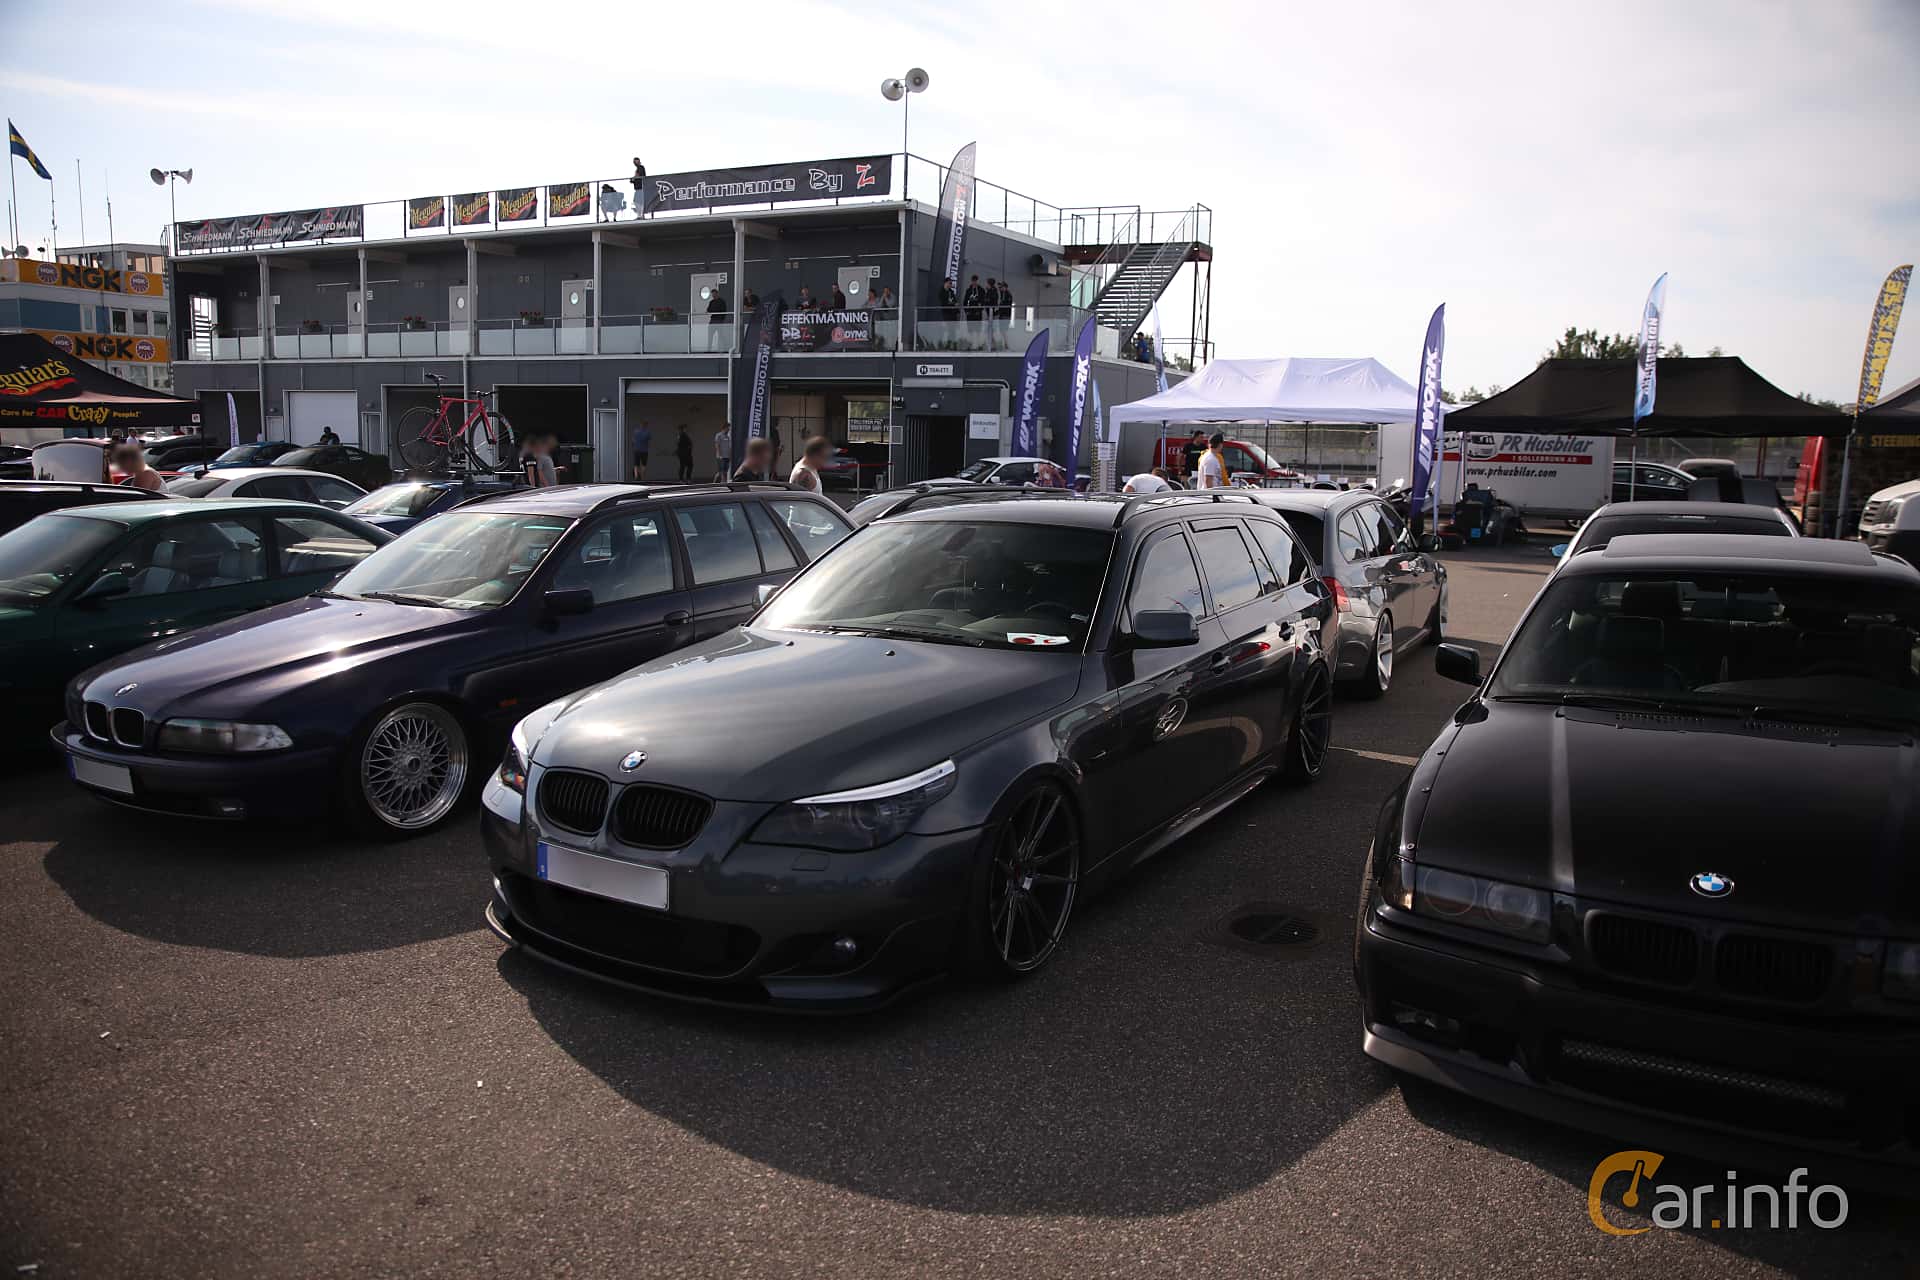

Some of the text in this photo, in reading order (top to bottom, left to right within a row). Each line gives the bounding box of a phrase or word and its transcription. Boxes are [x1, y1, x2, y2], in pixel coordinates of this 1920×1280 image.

[656, 164, 876, 200] Performance By Z
[61, 265, 121, 292] NGK
[871, 267, 879, 277] 6
[781, 311, 869, 324] EFFEKTMÄTNING
[75, 336, 133, 359] NGK
[751, 344, 770, 439] MOTOROPTIMER
[1023, 361, 1041, 420] WORK
[1073, 355, 1090, 426] WORK
[1422, 346, 1440, 430] WORK
[67, 405, 110, 424] Crazy
[1500, 435, 1593, 453] PR Husbilar
